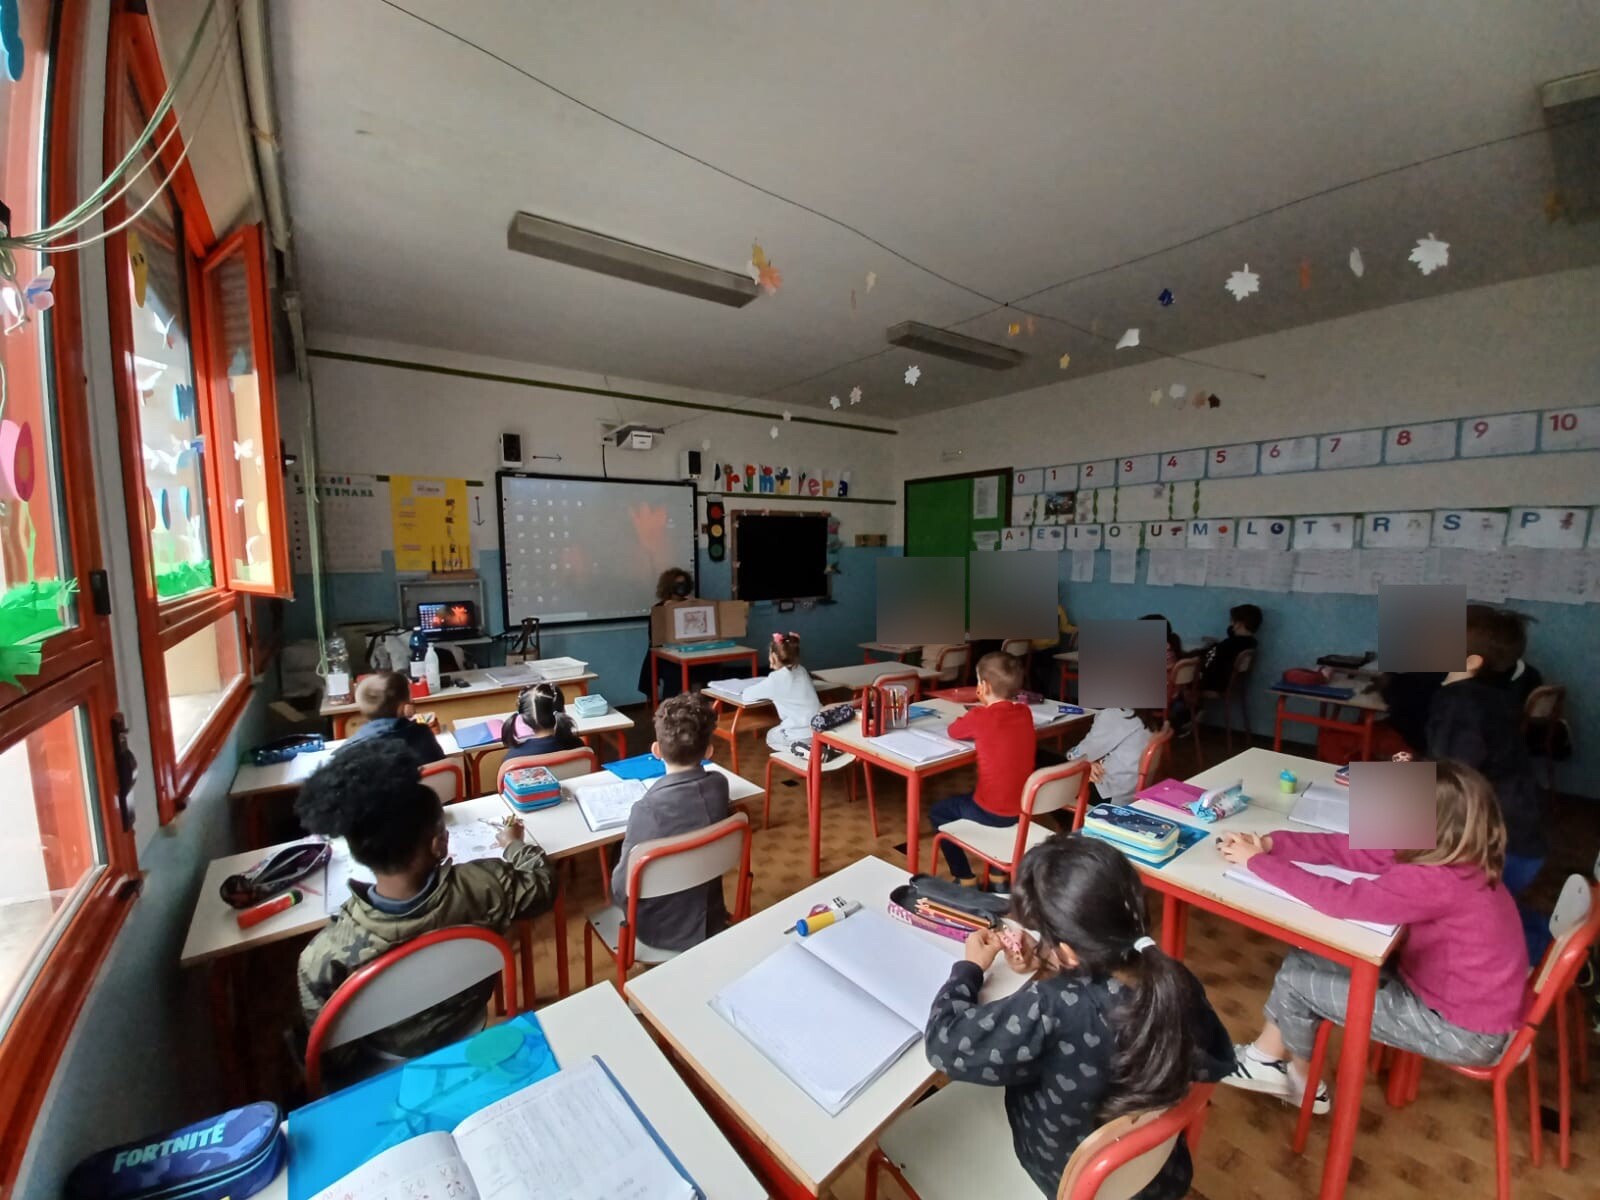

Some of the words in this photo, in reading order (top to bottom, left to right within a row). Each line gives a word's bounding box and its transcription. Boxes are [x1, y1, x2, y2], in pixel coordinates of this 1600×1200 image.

[1018, 474, 1025, 484] 0
[1051, 470, 1057, 480] 1
[1086, 466, 1094, 477] 2
[1124, 461, 1133, 472] 3
[1168, 456, 1178, 467] 4
[1216, 450, 1226, 463] 5
[1270, 445, 1280, 458] 6
[1330, 438, 1341, 452] 7
[1396, 430, 1412, 446] 8
[1474, 422, 1488, 438] 9
[1550, 414, 1577, 432] 10
[296, 487, 375, 497] STTIMANA
[1005, 529, 1013, 540] A
[1037, 528, 1045, 539] E
[1074, 527, 1078, 538] I
[1109, 526, 1120, 538] O
[1151, 525, 1162, 537] U
[1193, 522, 1208, 535] M
[1247, 522, 1258, 534] L
[1304, 521, 1317, 534] T
[1373, 517, 1390, 532] R
[1443, 514, 1461, 530] S
[1521, 512, 1540, 528] P
[112, 1122, 226, 1174] FORTNITE
